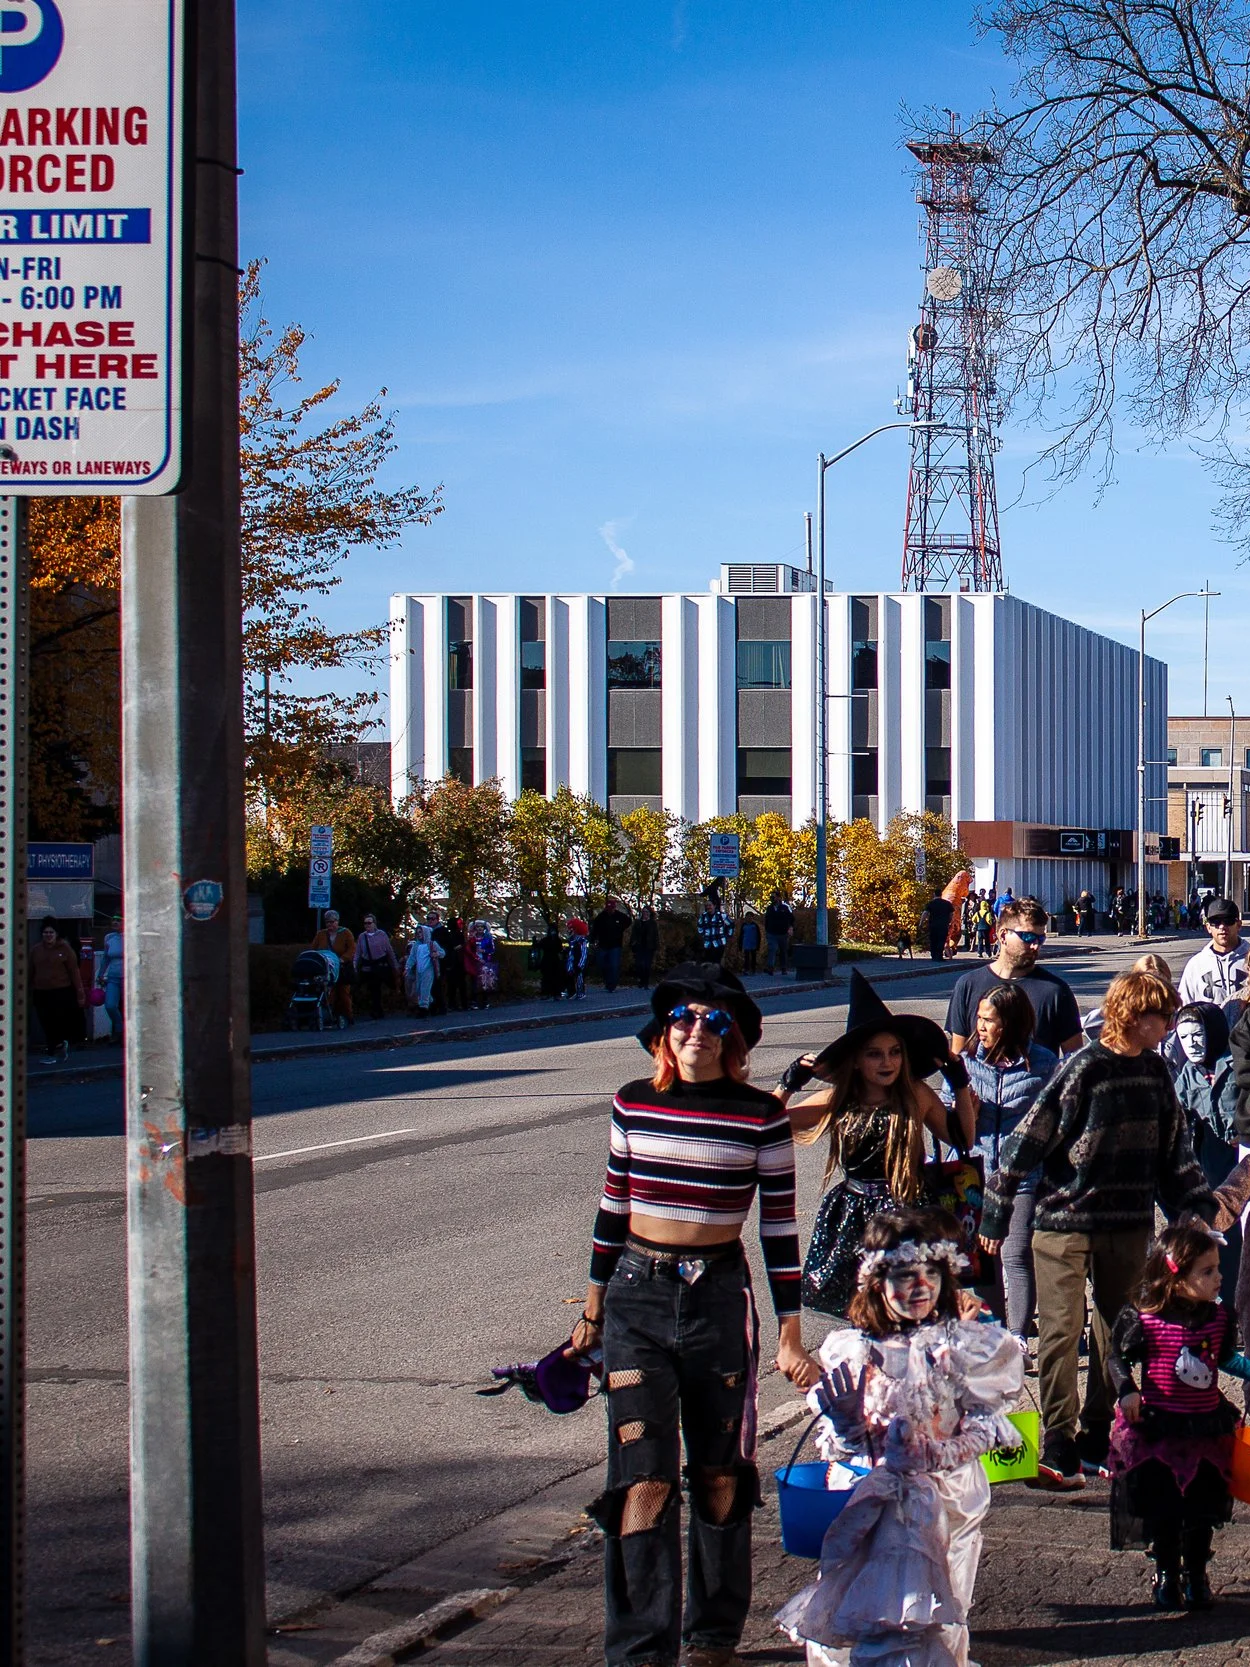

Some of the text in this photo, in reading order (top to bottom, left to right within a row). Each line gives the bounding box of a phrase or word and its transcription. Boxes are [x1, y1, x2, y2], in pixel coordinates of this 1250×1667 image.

[0, 106, 148, 146] ARKING
[0, 154, 115, 193] RCED
[31, 214, 129, 239] LIMIT
[0, 257, 61, 281] N-FRI
[20, 286, 75, 310] 6:00
[84, 286, 122, 309] PM
[35, 354, 158, 379] HERE
[65, 387, 127, 411] FACE
[16, 416, 80, 440] DASH
[52, 461, 71, 475] OR
[77, 460, 151, 475] LANEWAYS
[38, 853, 91, 869] PHYSIOTHERAPY
